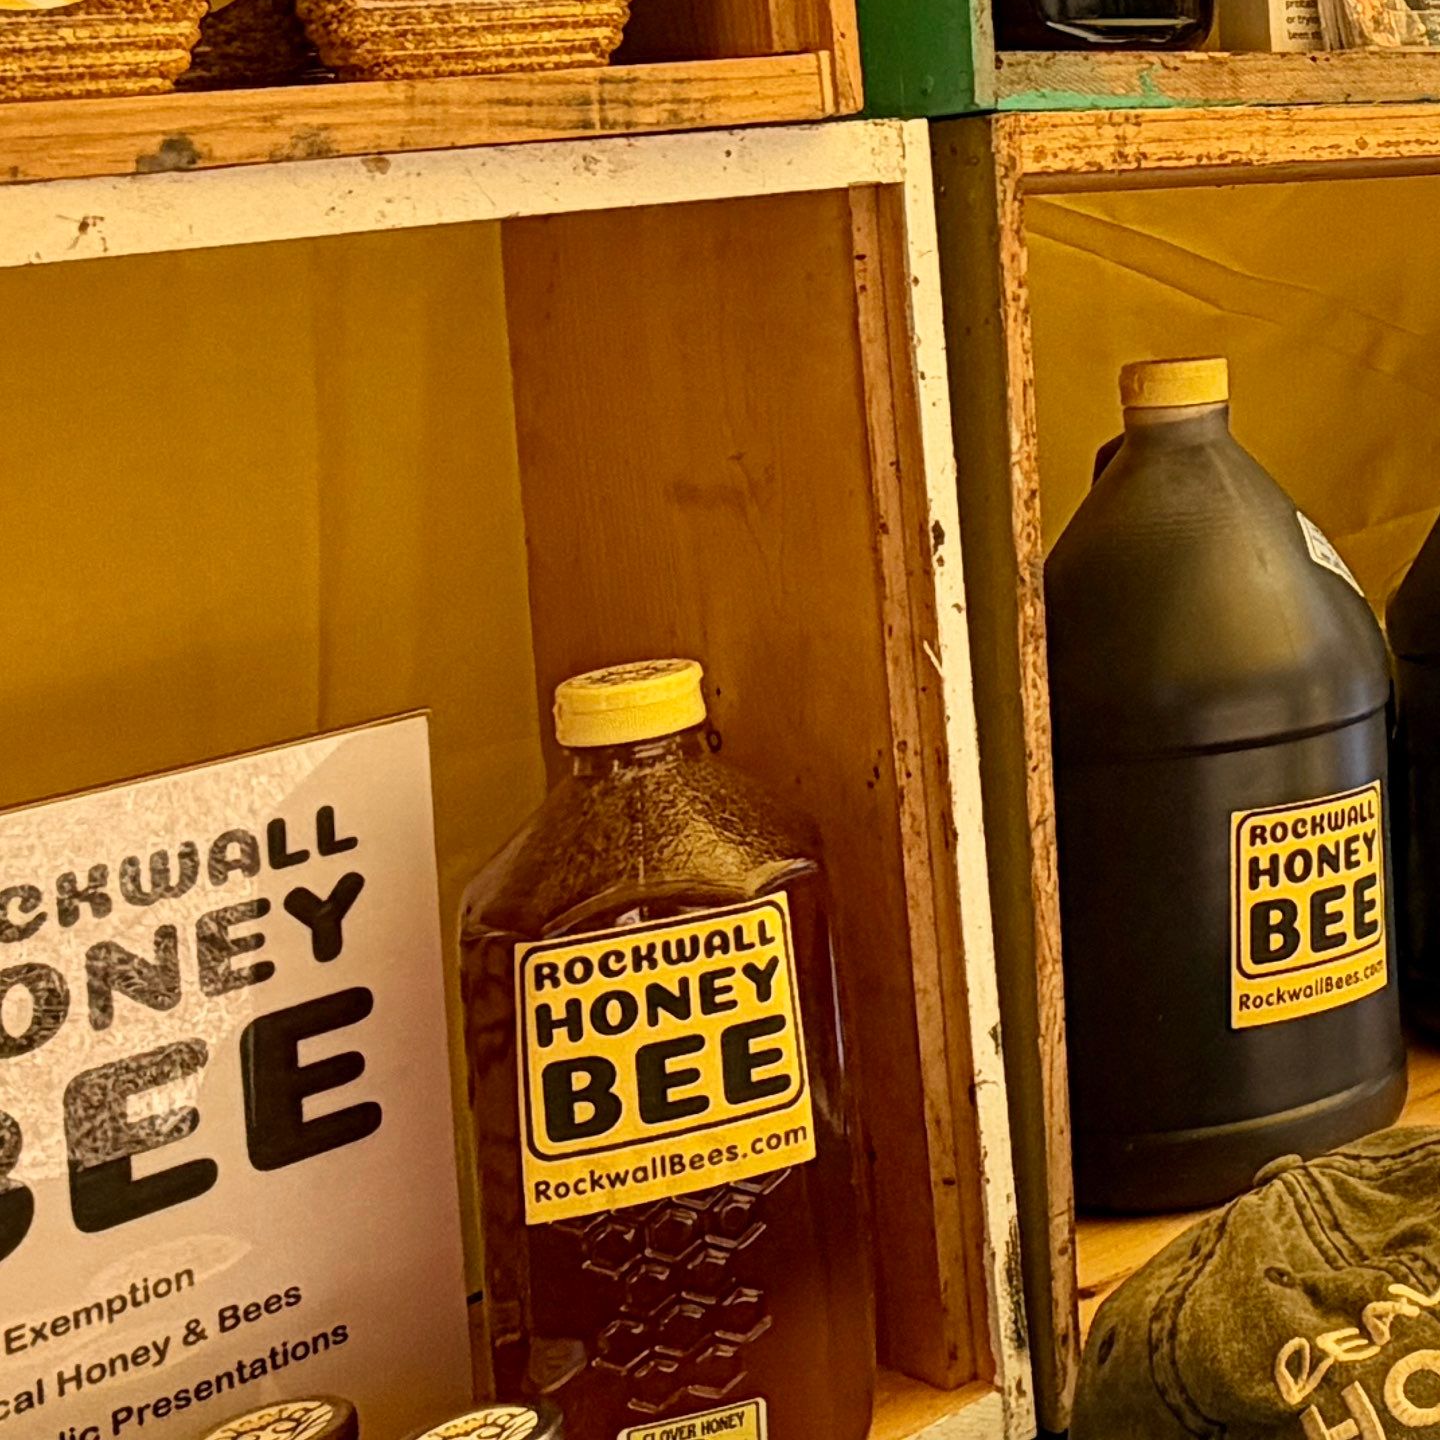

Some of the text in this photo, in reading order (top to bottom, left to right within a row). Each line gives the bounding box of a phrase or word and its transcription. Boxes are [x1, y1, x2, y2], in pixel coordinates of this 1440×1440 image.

[1247, 828, 1377, 892] HONEY
[1248, 798, 1376, 848] ROCKWALL
[533, 919, 776, 993] ROCKWALL
[1249, 873, 1379, 967] BEE
[534, 955, 780, 1050] HONEY
[1238, 959, 1385, 1012] RockwallBees.com
[540, 1013, 792, 1145] BEE
[534, 1122, 808, 1204] RockwallBees.com
[4, 1268, 195, 1355] Exemption
[57, 1335, 172, 1398] Honey
[181, 1318, 208, 1348] &
[217, 1285, 303, 1335] Bees
[111, 1324, 349, 1437] Presentations
[701, 1411, 745, 1435] HONEY
